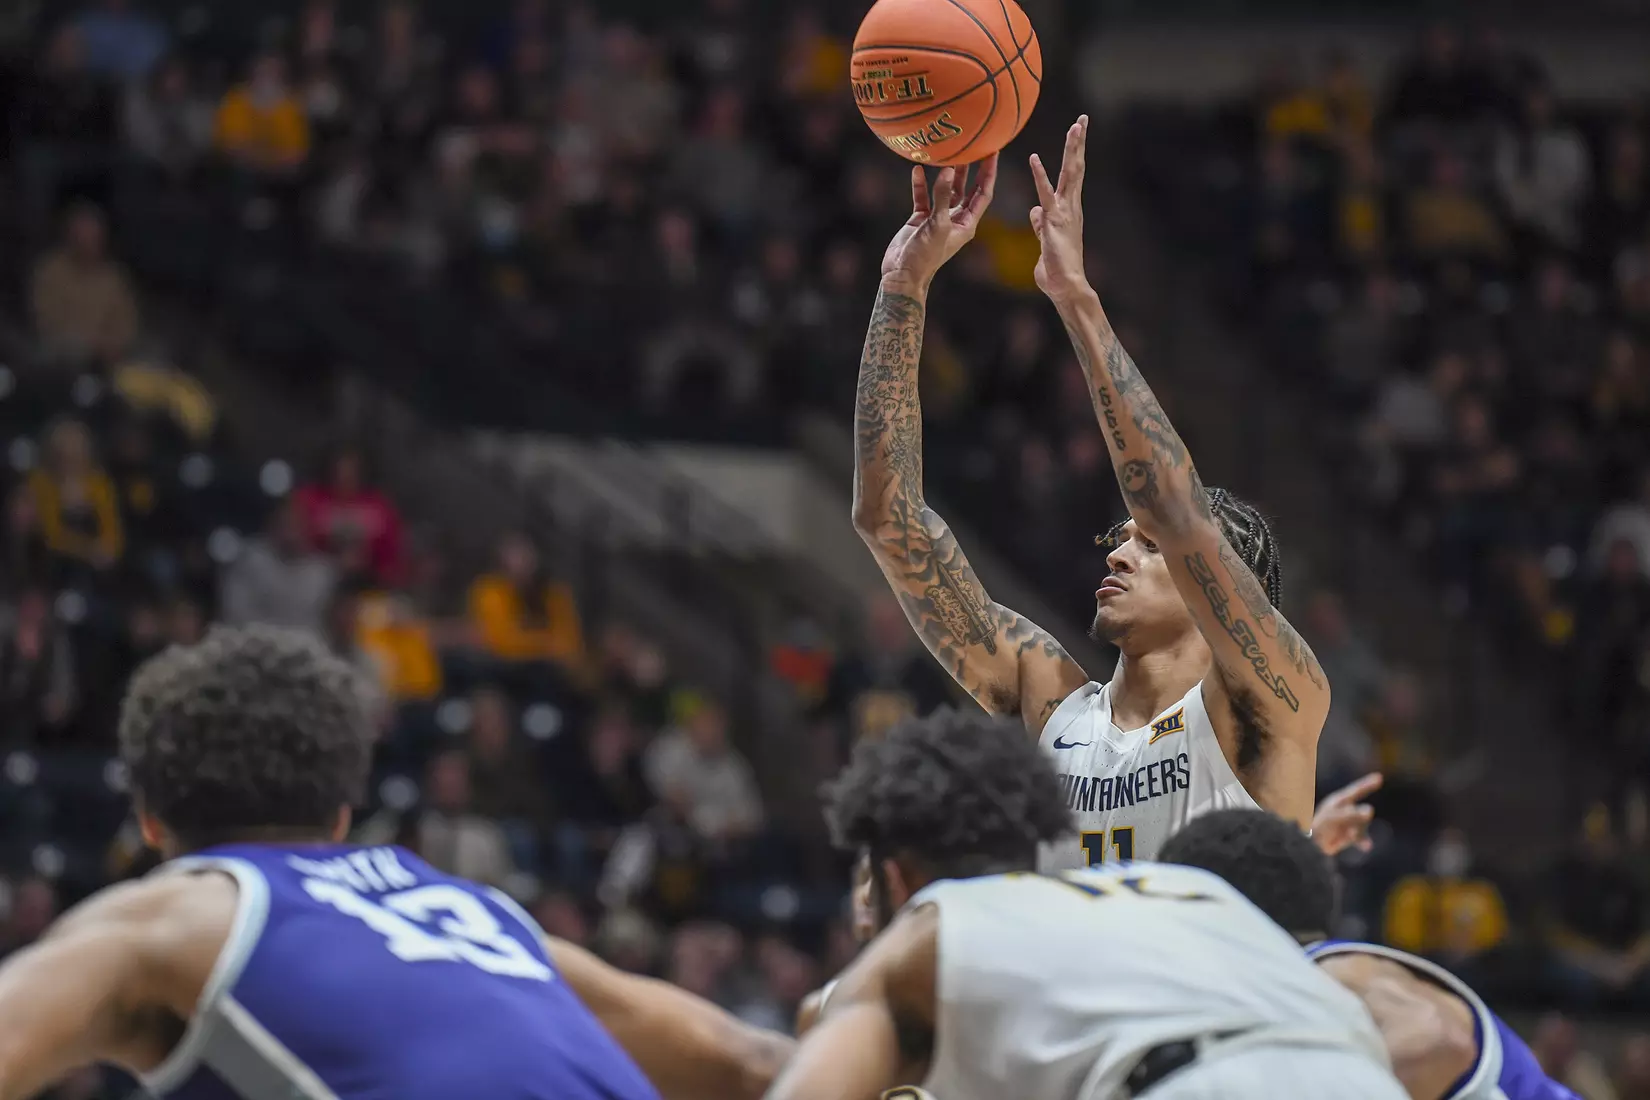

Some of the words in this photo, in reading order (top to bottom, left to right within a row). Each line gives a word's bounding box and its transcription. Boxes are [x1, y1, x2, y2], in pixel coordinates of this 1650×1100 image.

[883, 110, 962, 151] SPAL
[1151, 710, 1183, 740] XII
[1057, 753, 1190, 812] UNTAINEERS
[1080, 826, 1134, 867] 11
